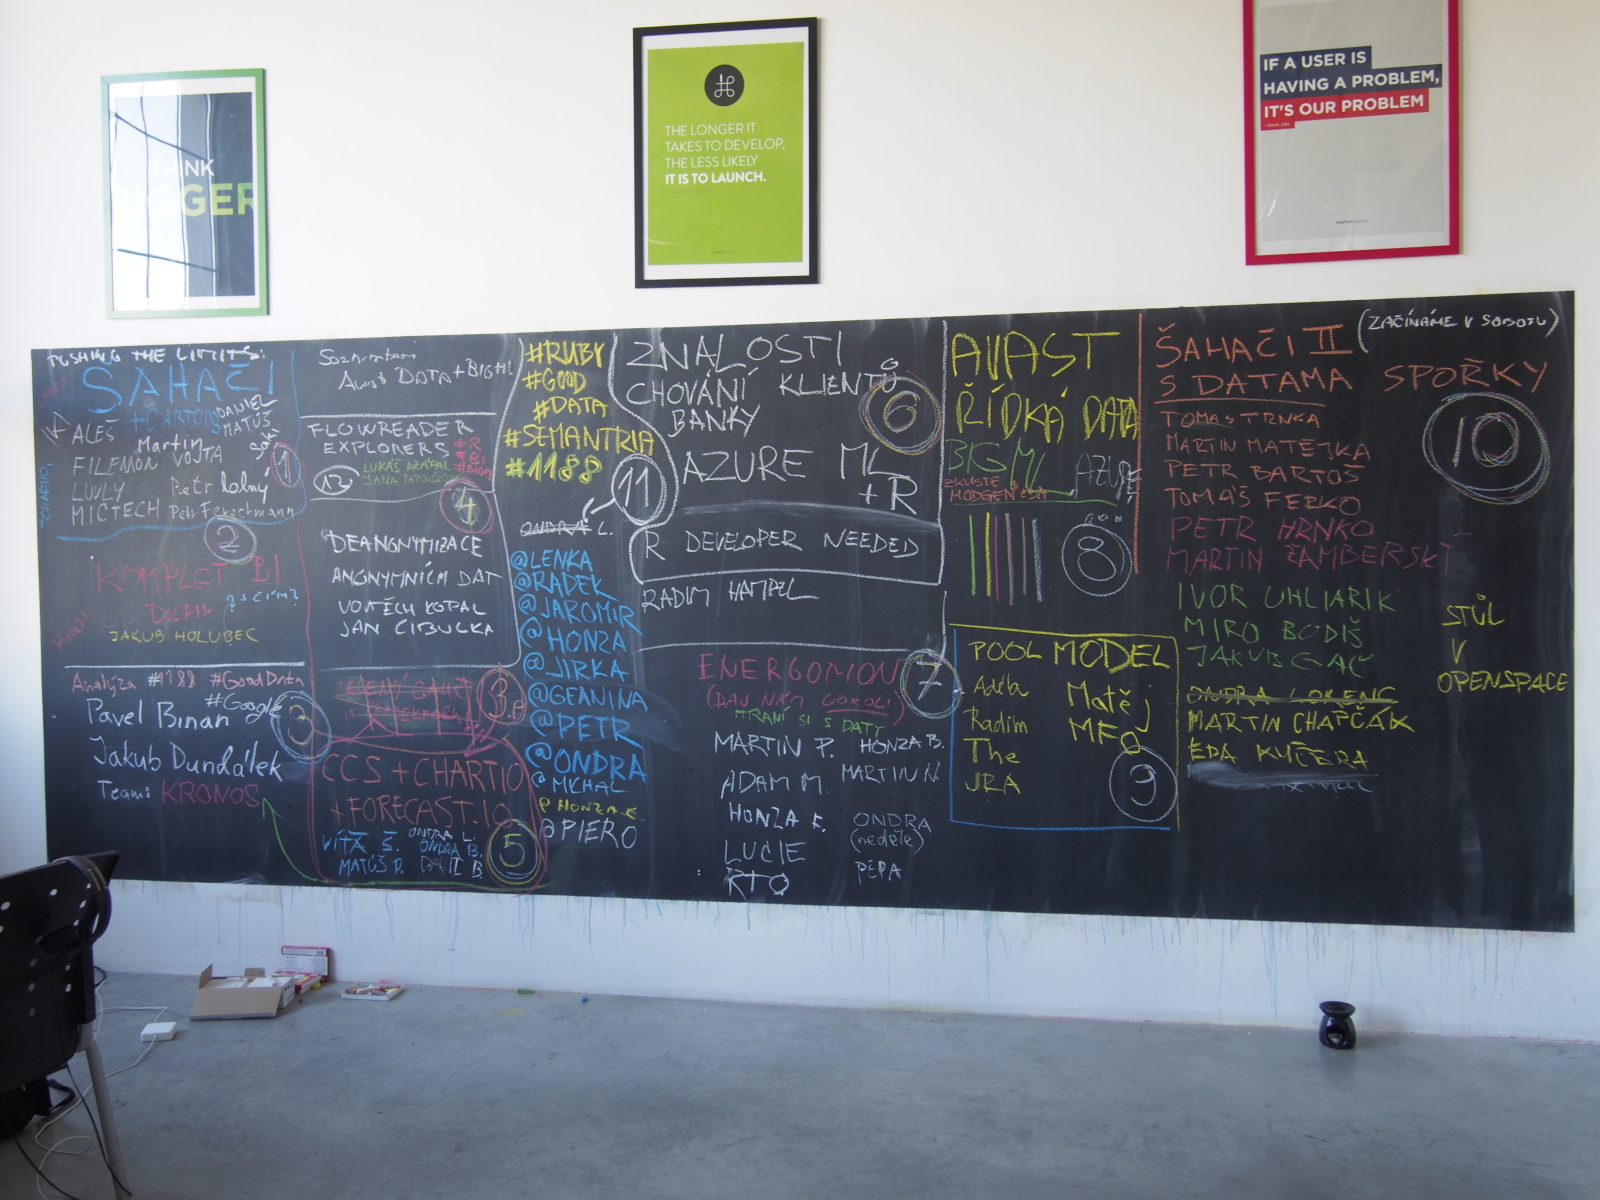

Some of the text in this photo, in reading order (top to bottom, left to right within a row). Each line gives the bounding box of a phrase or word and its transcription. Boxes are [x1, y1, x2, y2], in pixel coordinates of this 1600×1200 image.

[1264, 51, 1367, 71] IF A USER IS
[1264, 70, 1439, 95] HAVING A PROBLEM,
[1264, 95, 1424, 118] IT'S OUR PROBLEM
[665, 123, 756, 136] THE LONGER IT
[665, 138, 785, 152] TAKES TO DEVELOP,
[151, 159, 215, 178] THINK
[665, 155, 759, 169] THE LESS LIKELY
[665, 171, 766, 185] IT IS TO LAUNCH.
[132, 348, 166, 362] THE
[525, 339, 605, 368] #RUBY
[626, 331, 842, 372] ZNALOSTI
[952, 331, 1121, 381] AVAST
[522, 368, 587, 394] #GOOD
[1160, 367, 1352, 396] S DATAMA
[217, 394, 278, 419] DANIEL
[533, 396, 608, 424] #DATA
[883, 390, 920, 433] 6
[1240, 412, 1320, 428] TRNKA
[668, 404, 760, 437] BANKY
[138, 434, 202, 453] Martin
[323, 441, 450, 458] EXPLORERS
[503, 423, 655, 456] #SEMANTRIA
[1166, 432, 1236, 452] MARTIN
[1453, 412, 1520, 467] 10
[73, 456, 158, 476] FILEMON
[172, 445, 223, 467] VOJTA
[505, 451, 603, 484] #1188
[683, 442, 911, 484] AZURE ML
[945, 439, 1007, 474] BIG
[1164, 460, 1238, 479] PETR
[171, 476, 213, 496] Petr
[618, 467, 648, 507] 11
[72, 498, 160, 525] MICTECH
[454, 486, 477, 526] 4
[215, 525, 240, 554] 2
[1171, 516, 1256, 542] PETR
[645, 528, 919, 560] R DEVELOPER NEEDED
[509, 549, 594, 573] @LENKA
[1078, 536, 1117, 581] 8
[1166, 548, 1262, 576] MARTIN
[96, 554, 280, 597] KOMPLET BI
[457, 568, 503, 586] DAT
[514, 571, 619, 601] @RADEK
[642, 587, 709, 613] RADIM
[1178, 582, 1247, 610] IVOR
[109, 628, 259, 643] JAKUB HOLUBEC
[340, 620, 379, 637] JAN
[1184, 616, 1259, 643] MIRO
[968, 638, 1170, 674] POOL MODEL
[1187, 645, 1283, 667] JAKUB
[1452, 638, 1467, 664] V
[523, 652, 630, 682] @JIRKA
[1437, 670, 1568, 693] OPENSPACE
[205, 693, 282, 724] #Google
[528, 682, 648, 711] @GEANINA
[87, 698, 143, 727] Pavel
[288, 704, 314, 746] 3
[963, 706, 1028, 734] Radim
[1188, 710, 1281, 733] MARTIN
[530, 709, 643, 749] @PETR
[842, 719, 886, 738] DATY
[714, 731, 834, 758] MARTIN P.
[860, 734, 944, 755] HONZA B.
[963, 738, 1020, 764] The
[1188, 737, 1237, 764] EDA
[89, 736, 283, 782] Jakub Dundálek
[322, 754, 381, 783] CCS
[525, 742, 647, 783] @ONDRA
[721, 770, 789, 799] ADAM
[842, 764, 918, 784] MARTIN
[161, 780, 260, 807] KRONOS
[729, 802, 799, 829] HONZA
[853, 812, 932, 833] ONDRA
[409, 828, 453, 843] ONDRA
[539, 817, 637, 849] @PIERO
[500, 833, 525, 867] 5
[725, 840, 806, 865] LUCIE
